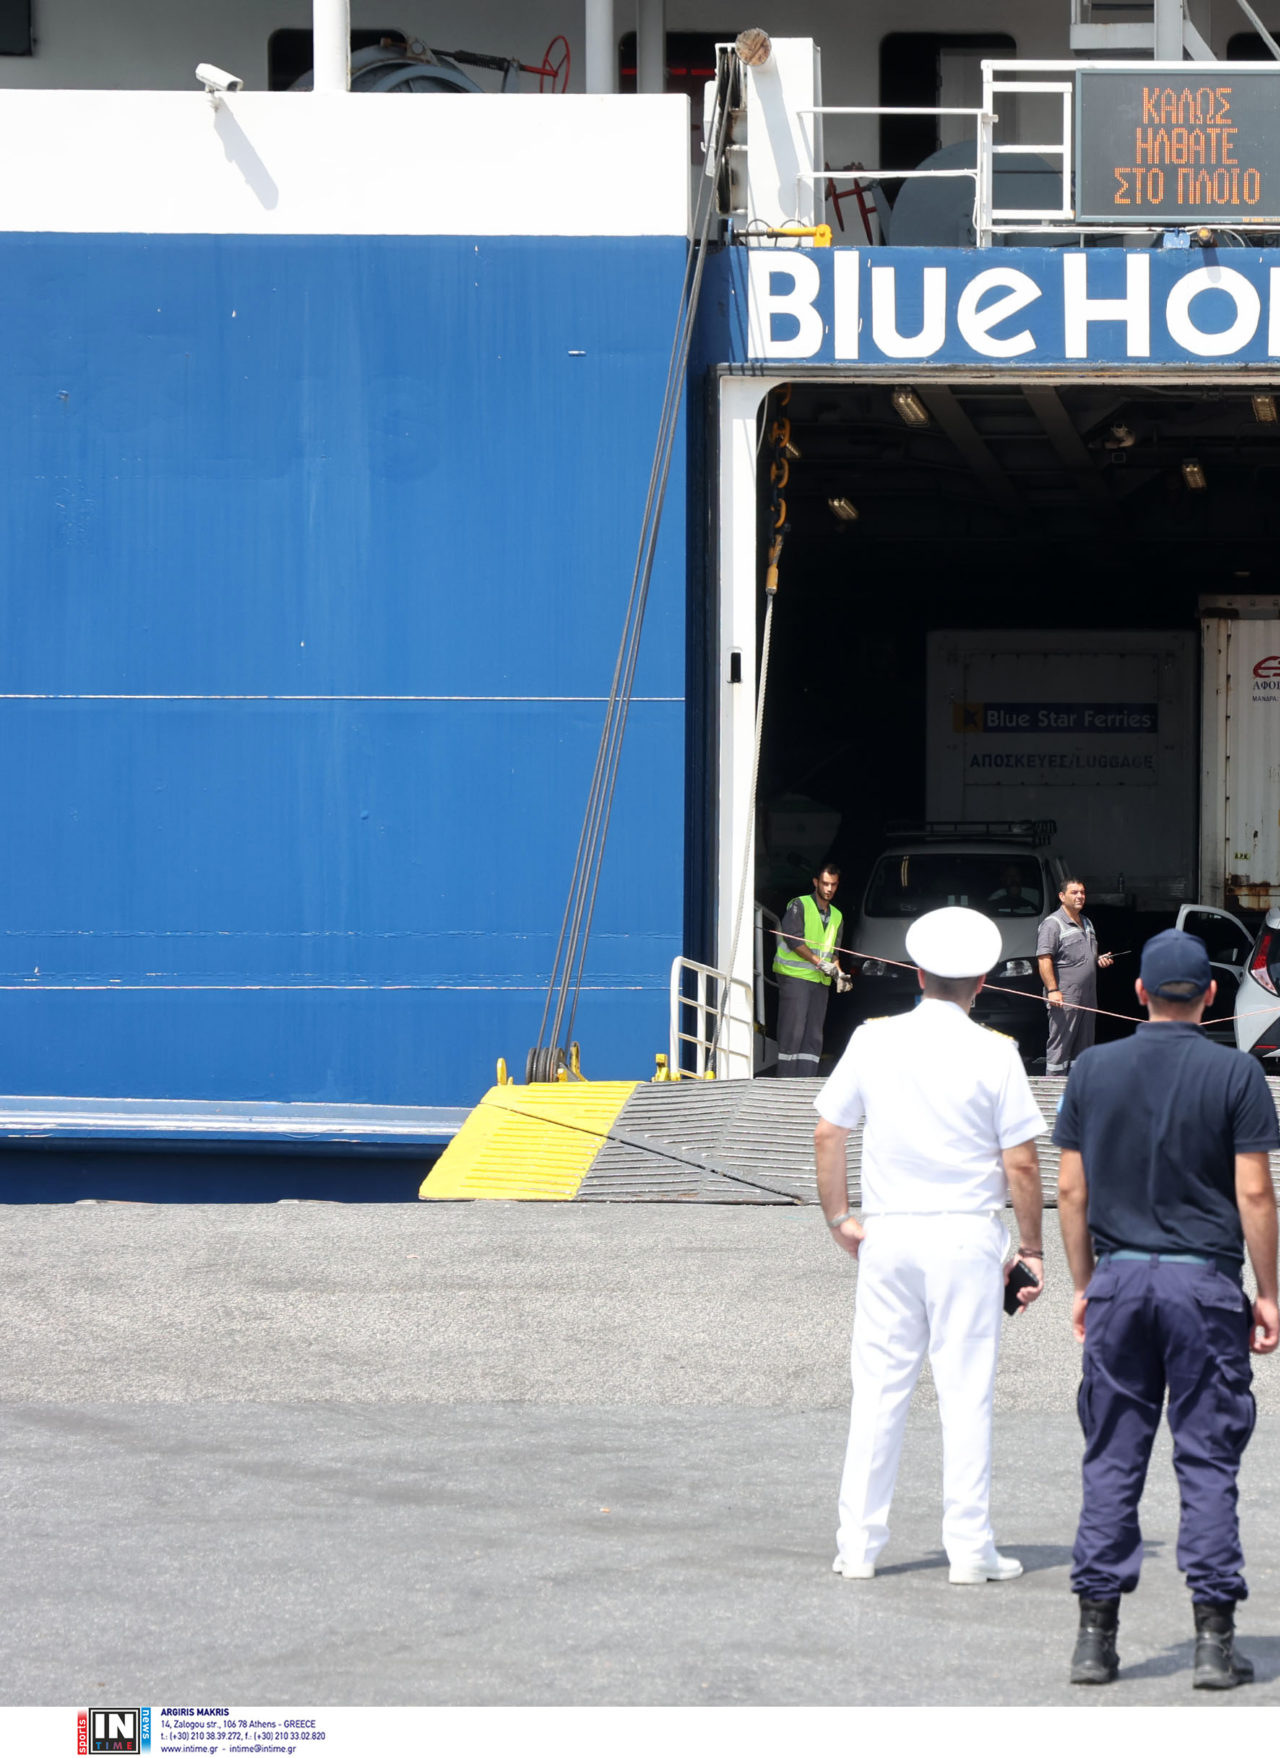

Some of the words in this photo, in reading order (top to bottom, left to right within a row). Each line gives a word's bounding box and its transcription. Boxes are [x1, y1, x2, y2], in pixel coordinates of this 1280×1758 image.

[1143, 87, 1232, 125] ΚΑΛΩΣ
[1136, 127, 1238, 165] ΗΛΘΑΤΕ
[1113, 167, 1164, 205] ΣΤΟ
[1178, 167, 1260, 205] ΠΛΟΙΟ
[748, 250, 1042, 360] Blue
[1252, 680, 1280, 691] ΑΦΟΙ
[986, 710, 1030, 727] Blue
[1038, 710, 1076, 727] Star
[1084, 710, 1151, 727] Ferries
